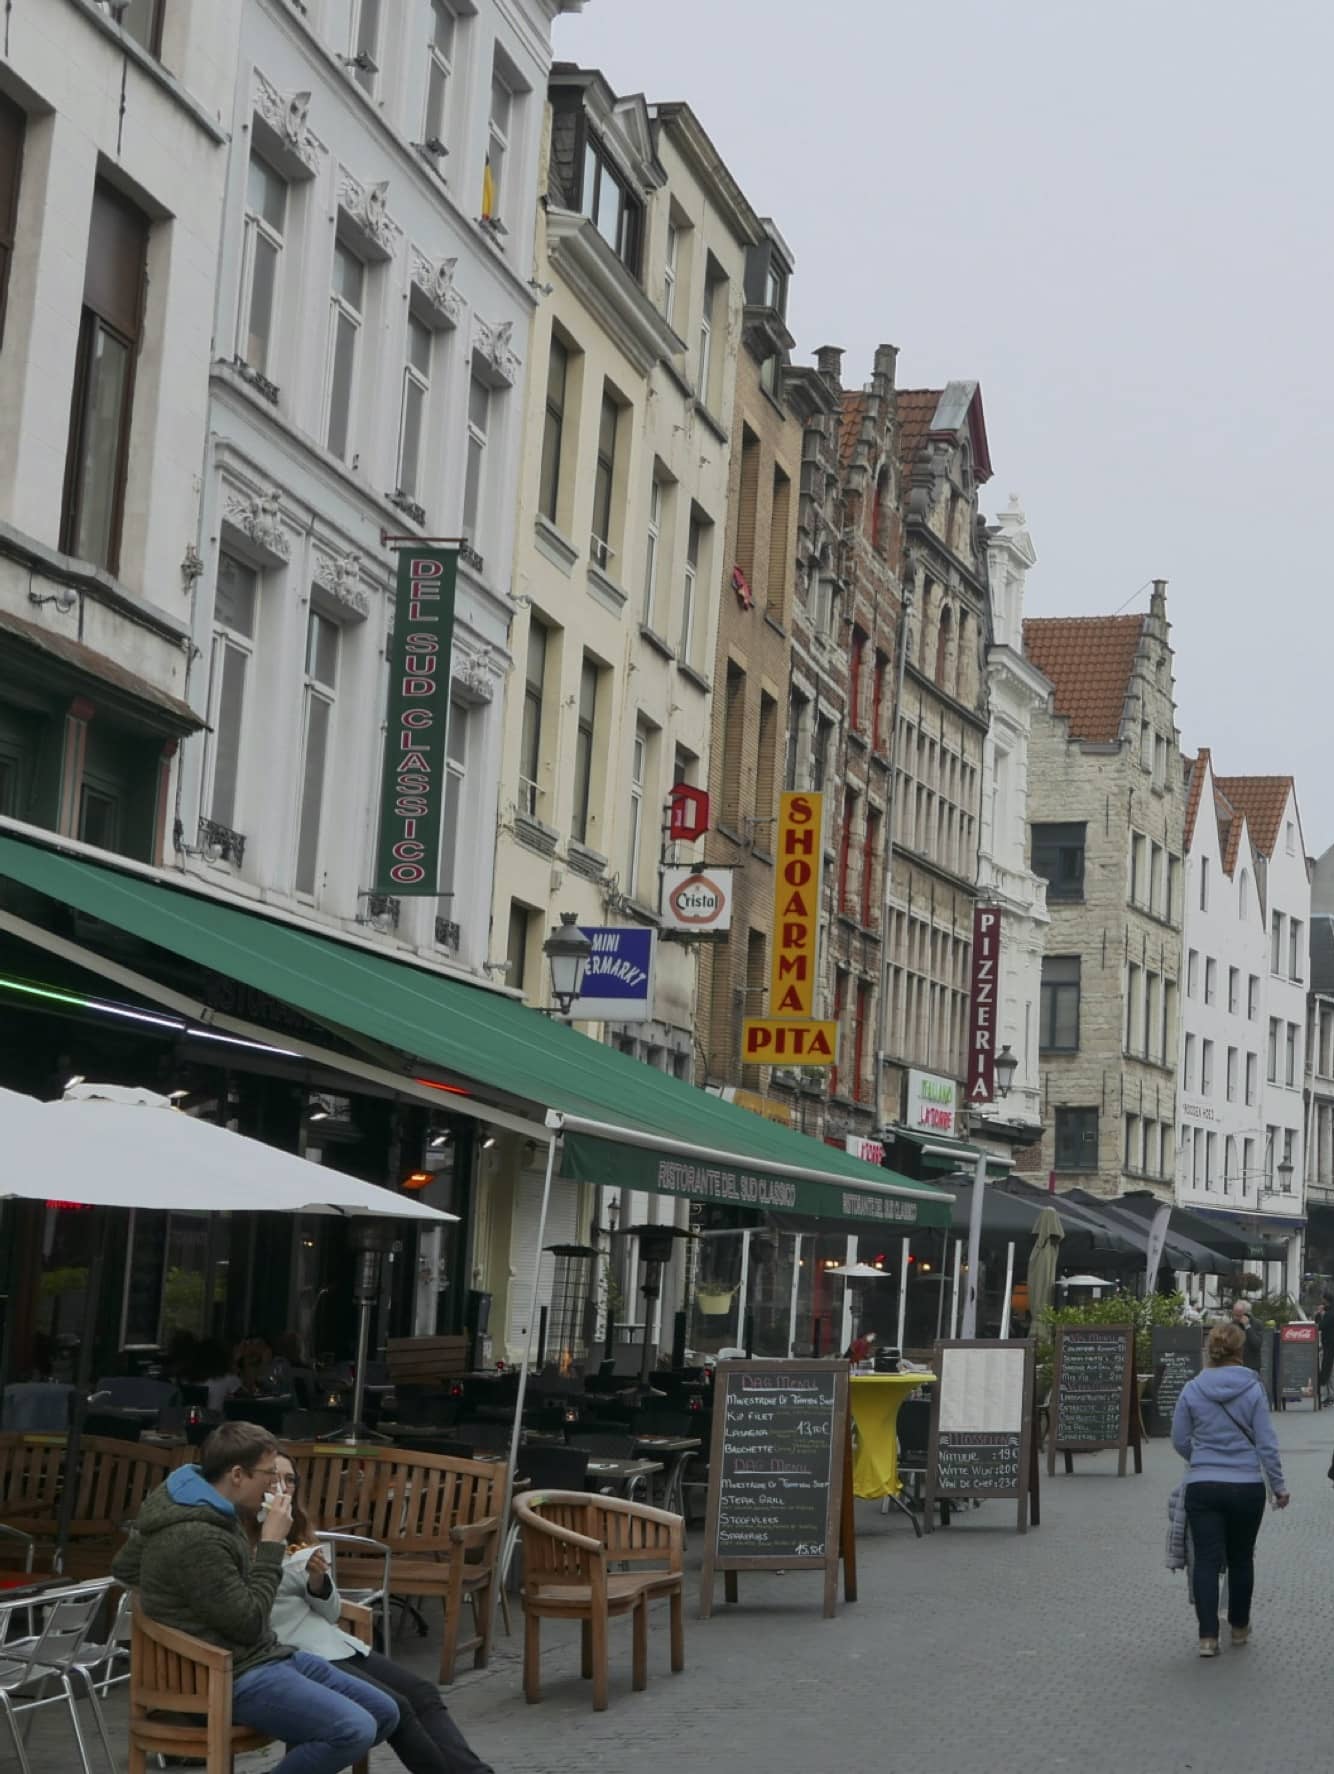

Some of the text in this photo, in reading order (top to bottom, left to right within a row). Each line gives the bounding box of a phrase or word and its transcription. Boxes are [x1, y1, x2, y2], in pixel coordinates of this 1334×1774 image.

[390, 558, 444, 884] DEL SUD CLASSICO
[592, 933, 620, 953] MINI
[676, 893, 719, 910] Cristal
[777, 796, 815, 1012] SHOARMA
[747, 1027, 832, 1055] PITA
[971, 914, 994, 1098] PIZZERIA
